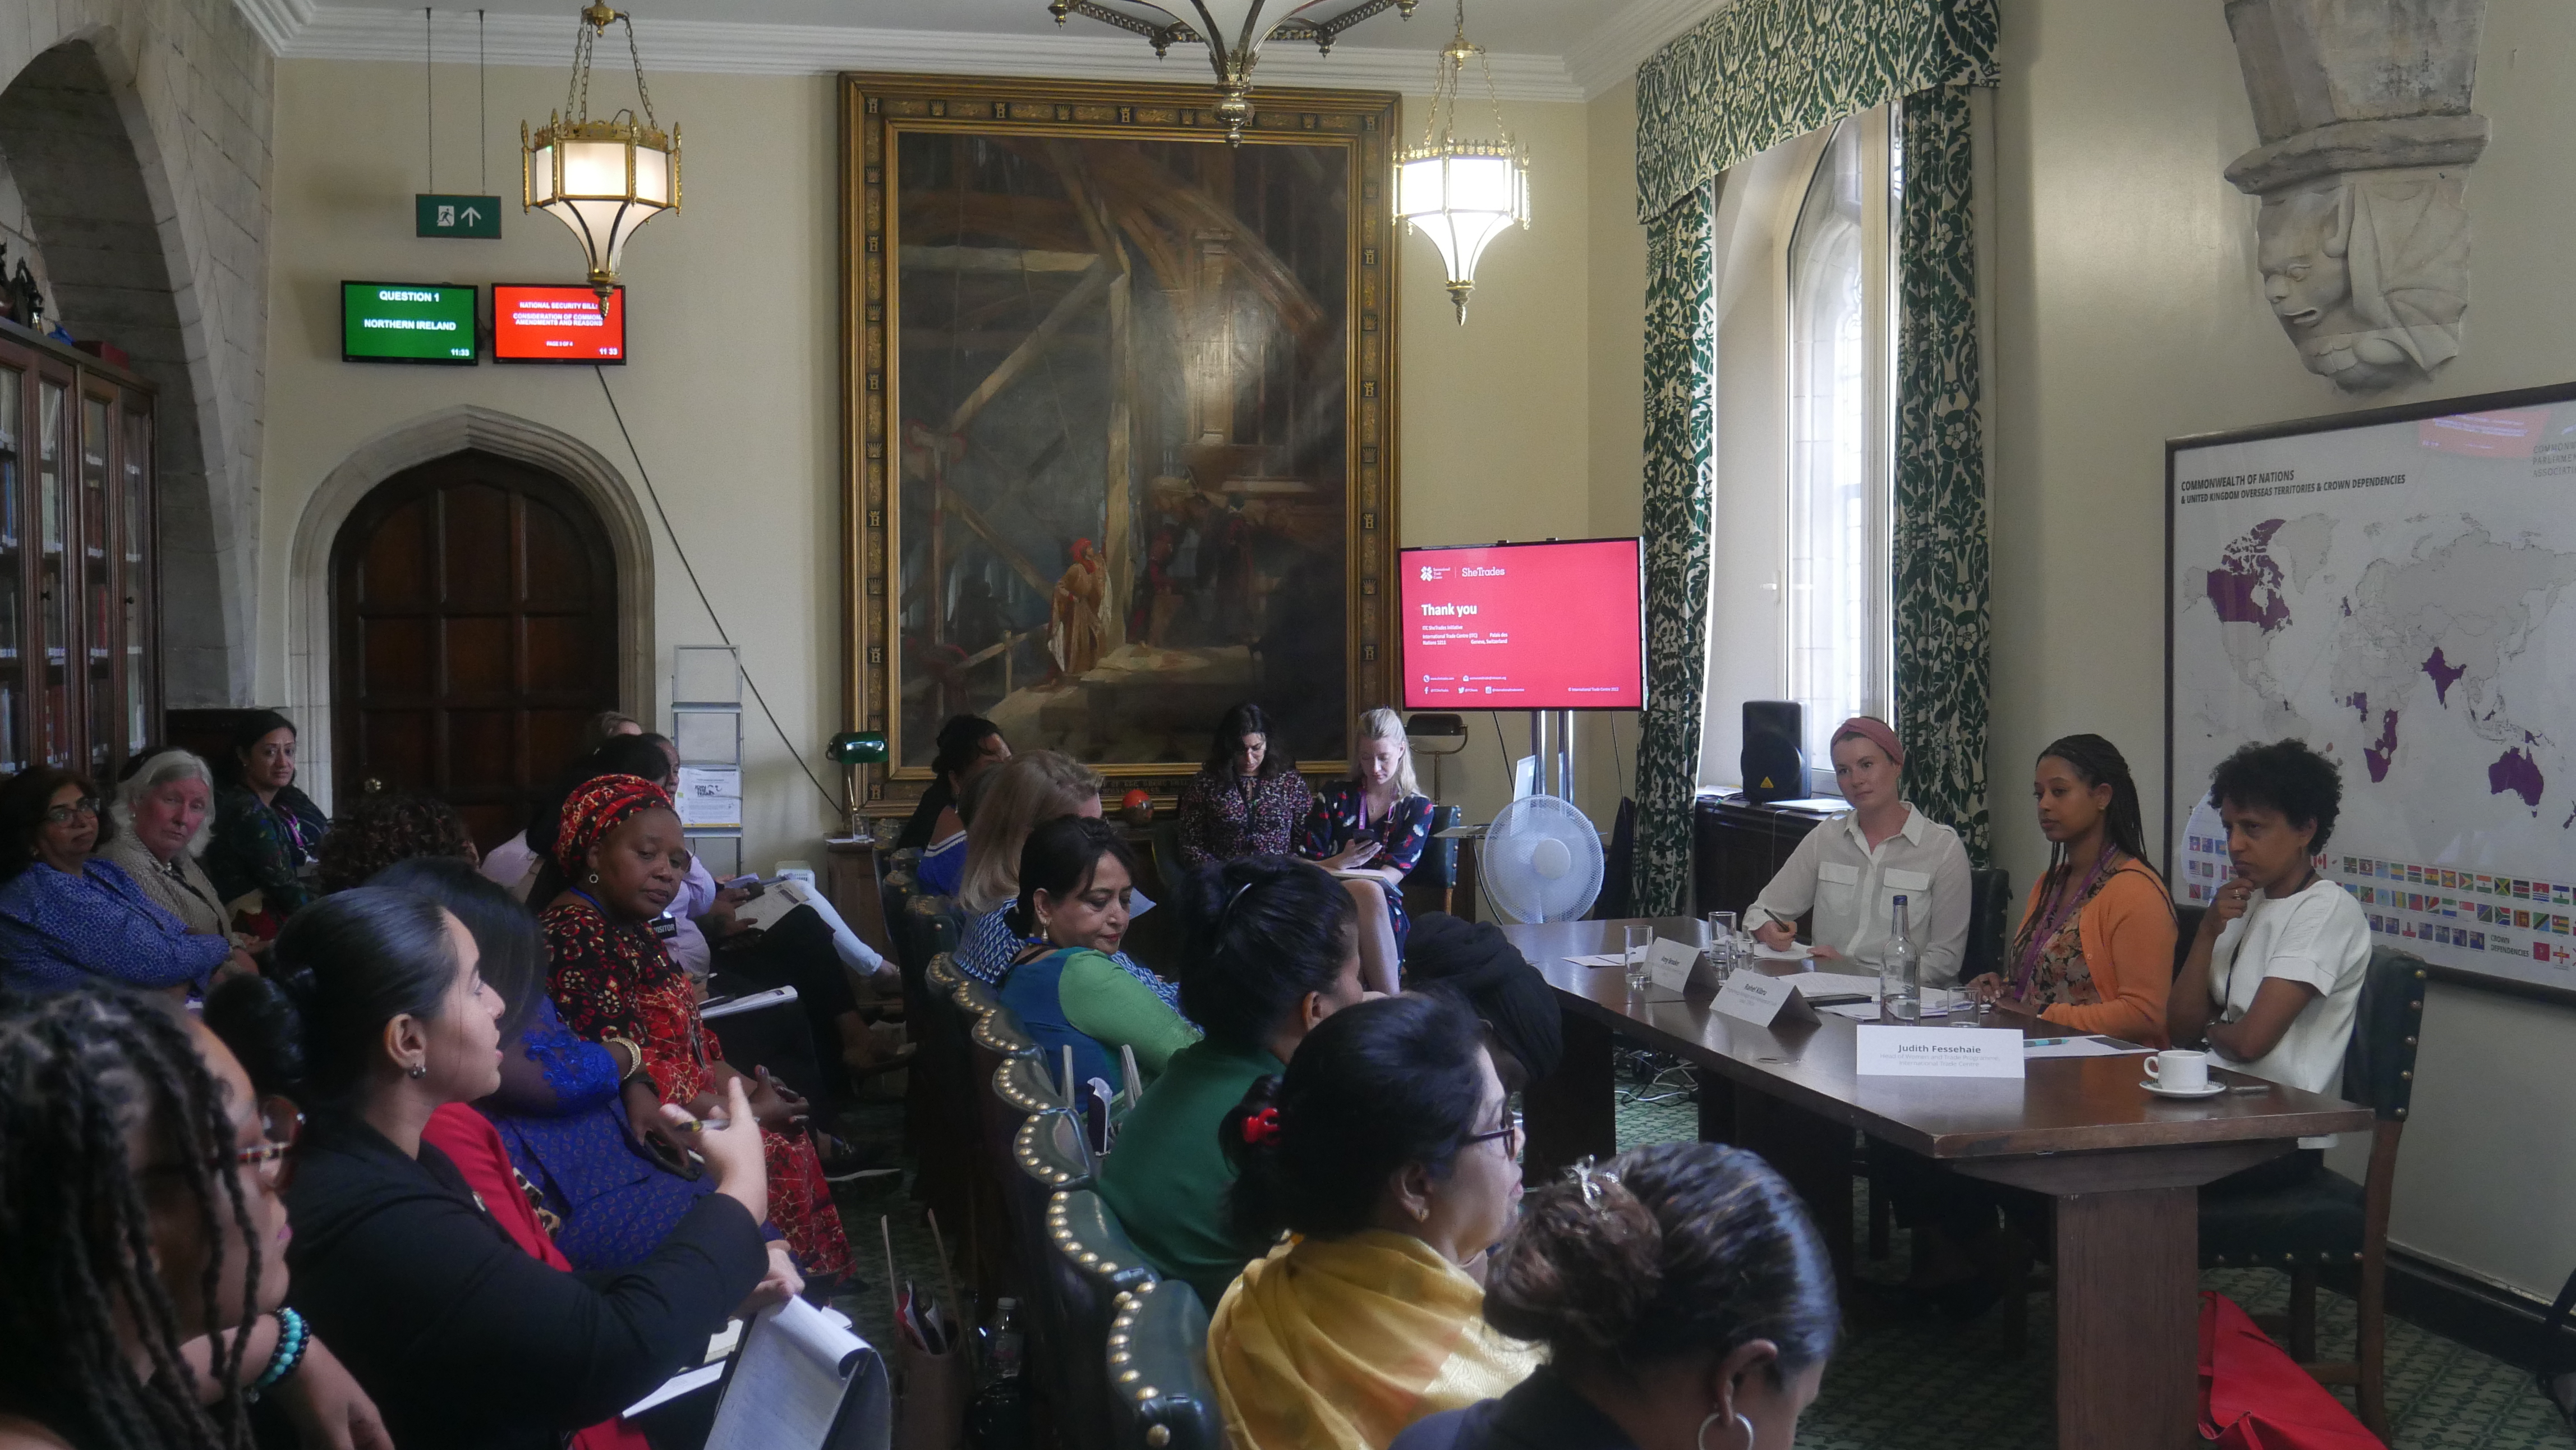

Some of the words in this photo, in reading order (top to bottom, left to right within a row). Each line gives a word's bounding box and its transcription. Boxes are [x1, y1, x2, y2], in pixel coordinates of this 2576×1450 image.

[379, 291, 431, 302] QUESTION
[434, 293, 440, 302] 1
[364, 319, 416, 330] NORTHERN
[416, 320, 456, 331] IRELAND
[450, 348, 470, 356] 11:33
[2181, 475, 2246, 492] COMMONWEALTH
[2247, 474, 2257, 485] OF
[2259, 470, 2294, 483] NATIONS
[2181, 495, 2186, 504] &
[2187, 493, 2209, 503] UNITED
[2209, 491, 2239, 502] KINGDOM
[2241, 487, 2273, 498] OVERSEAS
[2274, 483, 2315, 495] TERRITORIES
[2316, 483, 2322, 492] &
[2324, 480, 2350, 491] CROWN
[2352, 474, 2405, 489] DEPENDENCIES
[1461, 567, 1505, 577] SheTrades
[1421, 603, 1455, 616] Thank
[1456, 604, 1478, 618] you
[2491, 934, 2510, 944] CROWN
[2491, 944, 2529, 957] DEPENDENCIES
[1898, 1044, 1929, 1053] Judith
